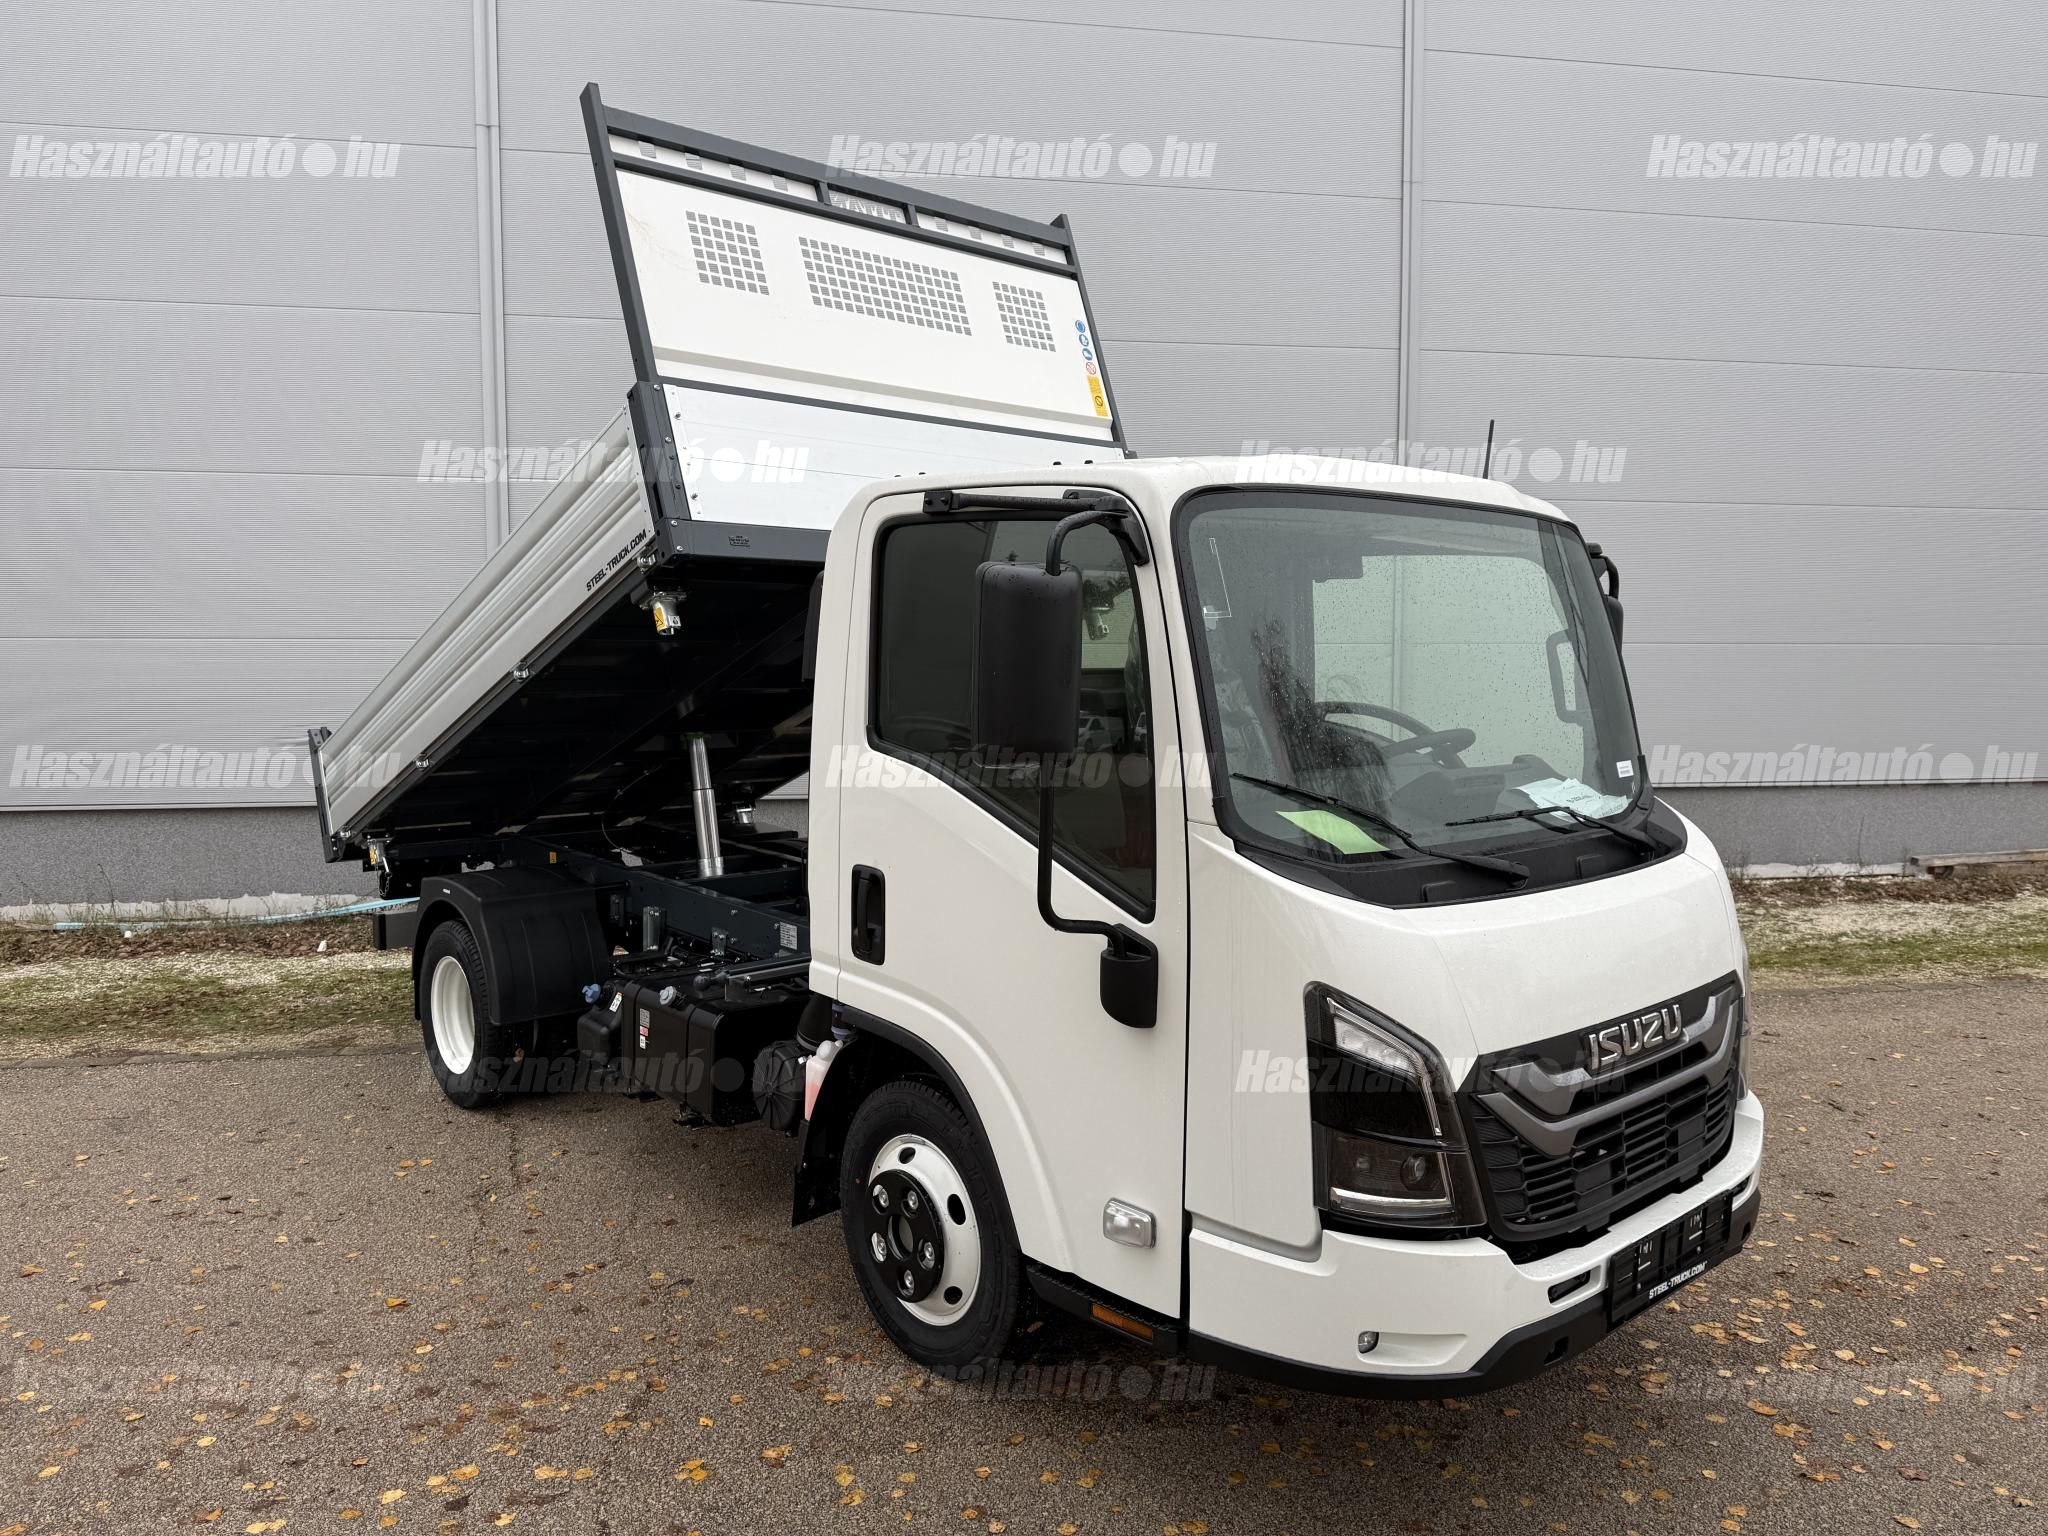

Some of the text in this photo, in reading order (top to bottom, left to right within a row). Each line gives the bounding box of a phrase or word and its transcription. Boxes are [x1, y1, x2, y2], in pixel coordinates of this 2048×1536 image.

[586, 529, 647, 592] STEEL-TRUCK.COM
[1589, 1004, 1682, 1070] ISUZU
[1649, 1261, 1707, 1299] STEEL-TRUCK.COM
